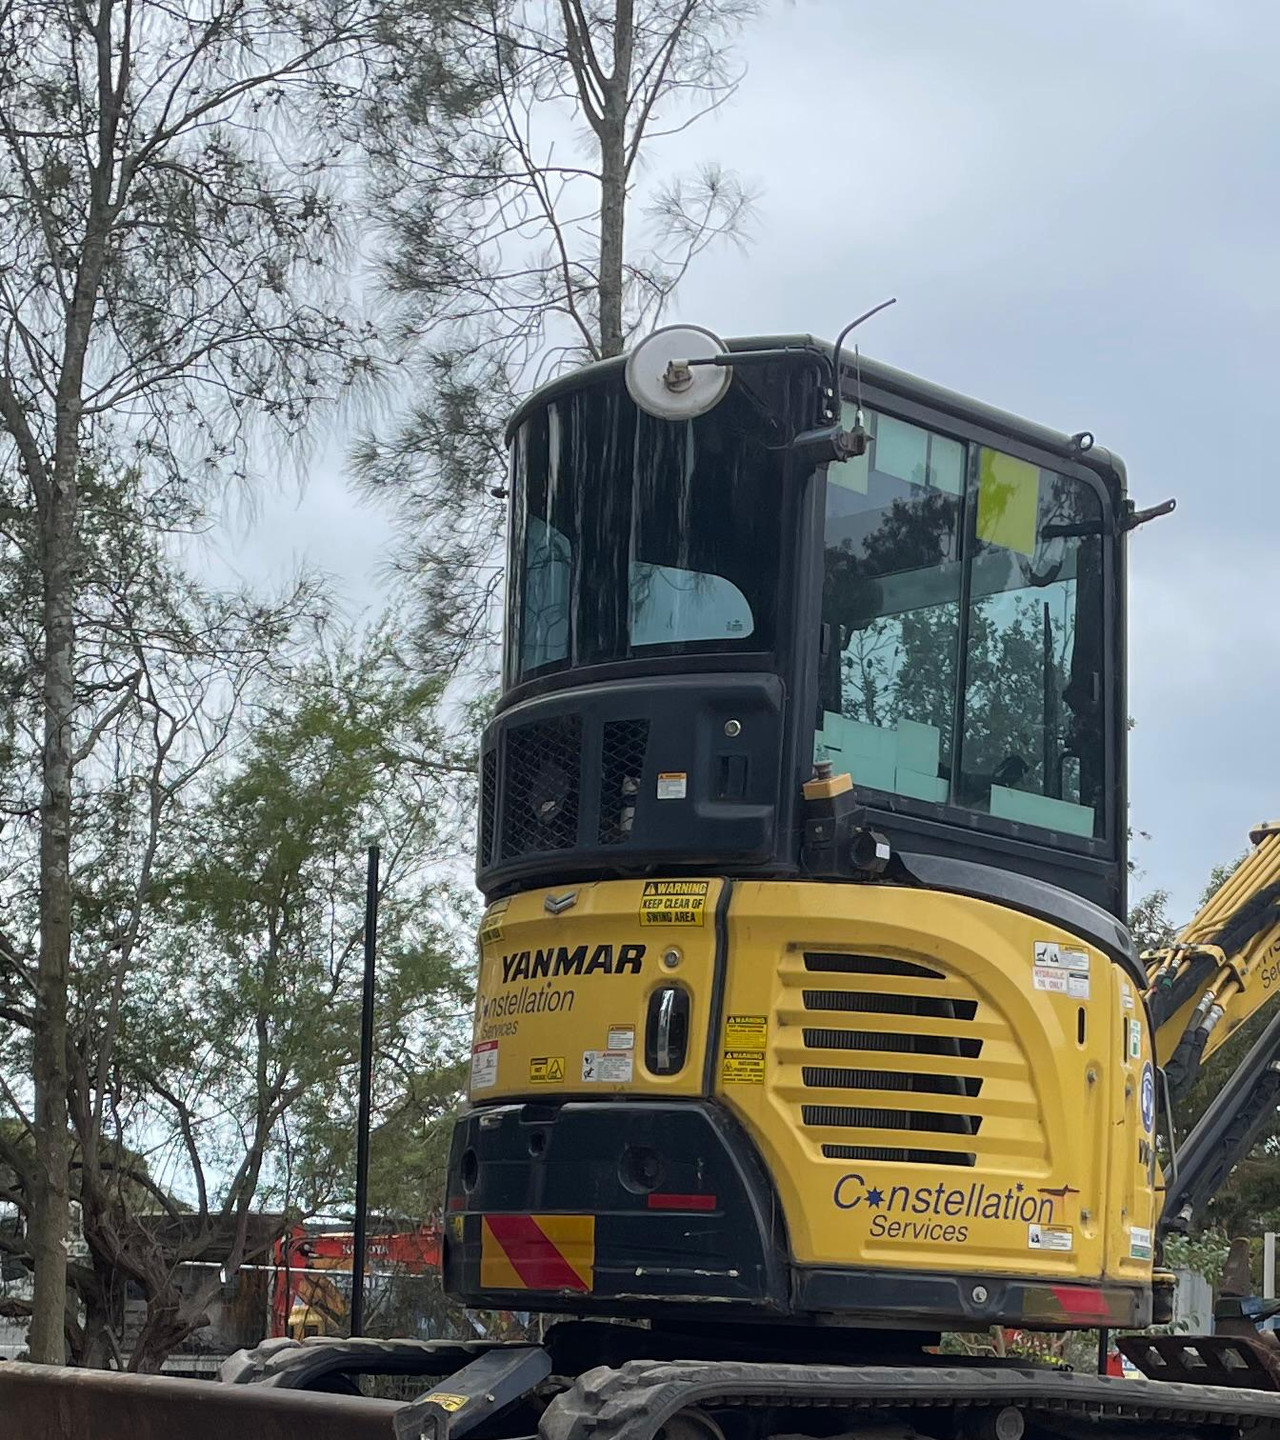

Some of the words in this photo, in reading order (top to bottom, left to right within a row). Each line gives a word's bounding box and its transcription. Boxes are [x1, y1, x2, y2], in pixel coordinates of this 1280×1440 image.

[657, 882, 708, 894] WARNING
[642, 898, 663, 909] KEEP
[664, 898, 690, 909] CLEAR
[691, 898, 704, 909] OF
[646, 911, 672, 923] SWING
[673, 911, 696, 923] AREA
[502, 944, 647, 985] YANMAR
[870, 1214, 969, 1242] Services
